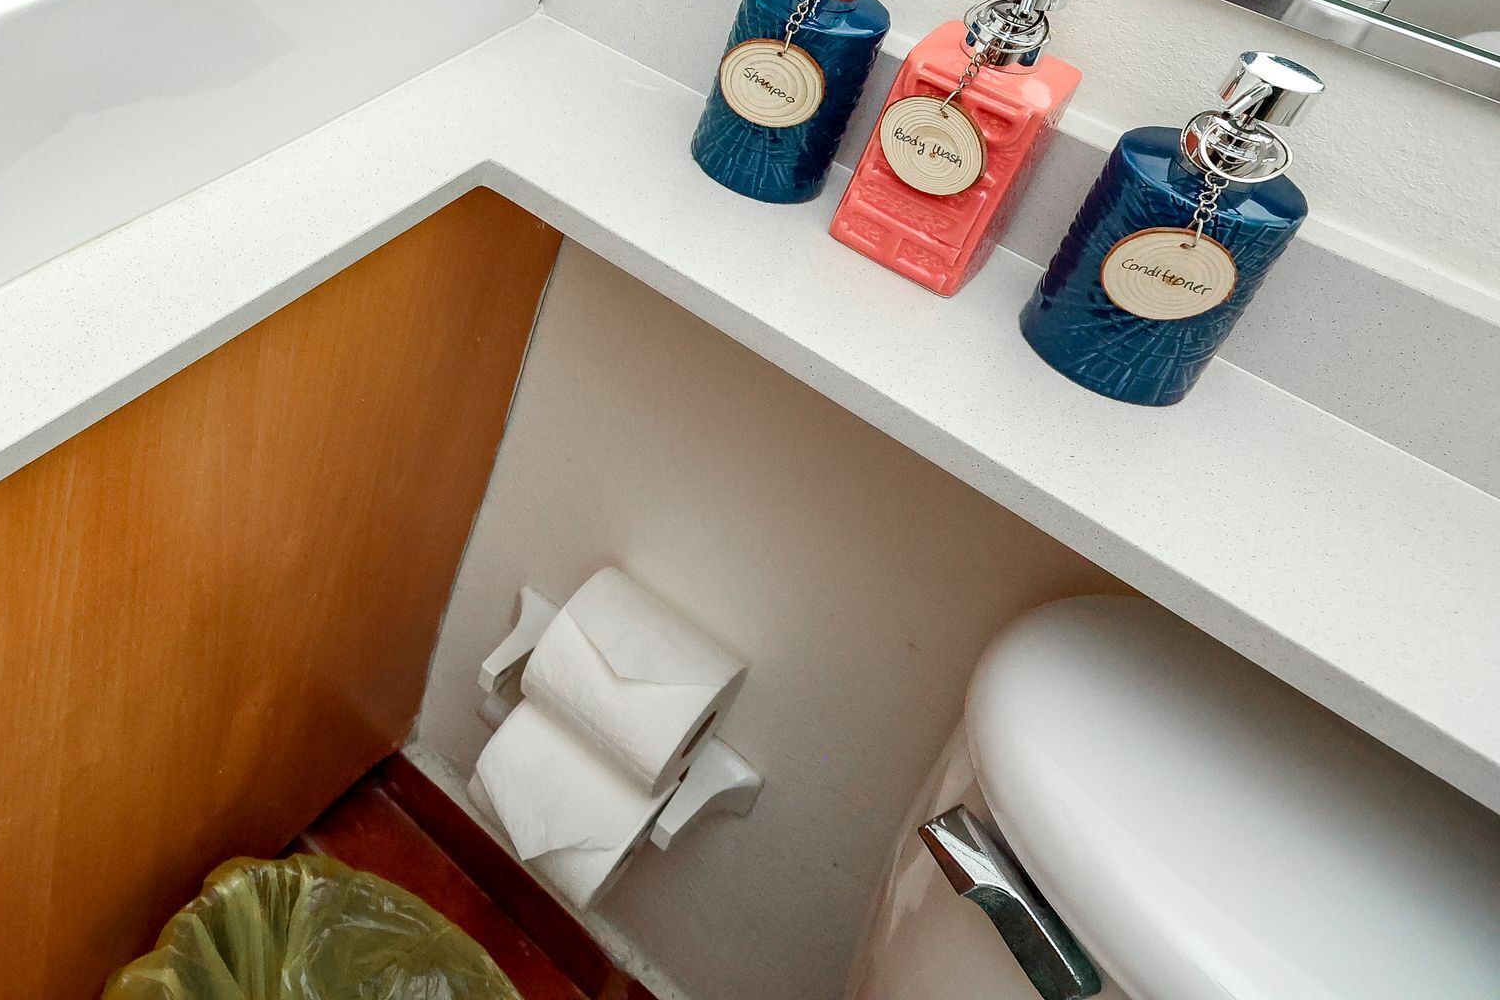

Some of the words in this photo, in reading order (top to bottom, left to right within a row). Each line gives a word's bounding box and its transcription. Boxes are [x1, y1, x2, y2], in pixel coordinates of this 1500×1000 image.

[743, 67, 795, 104] Shampoo
[894, 127, 925, 155] Body
[932, 144, 963, 168] Wash
[1121, 258, 1213, 296] Conditioner
